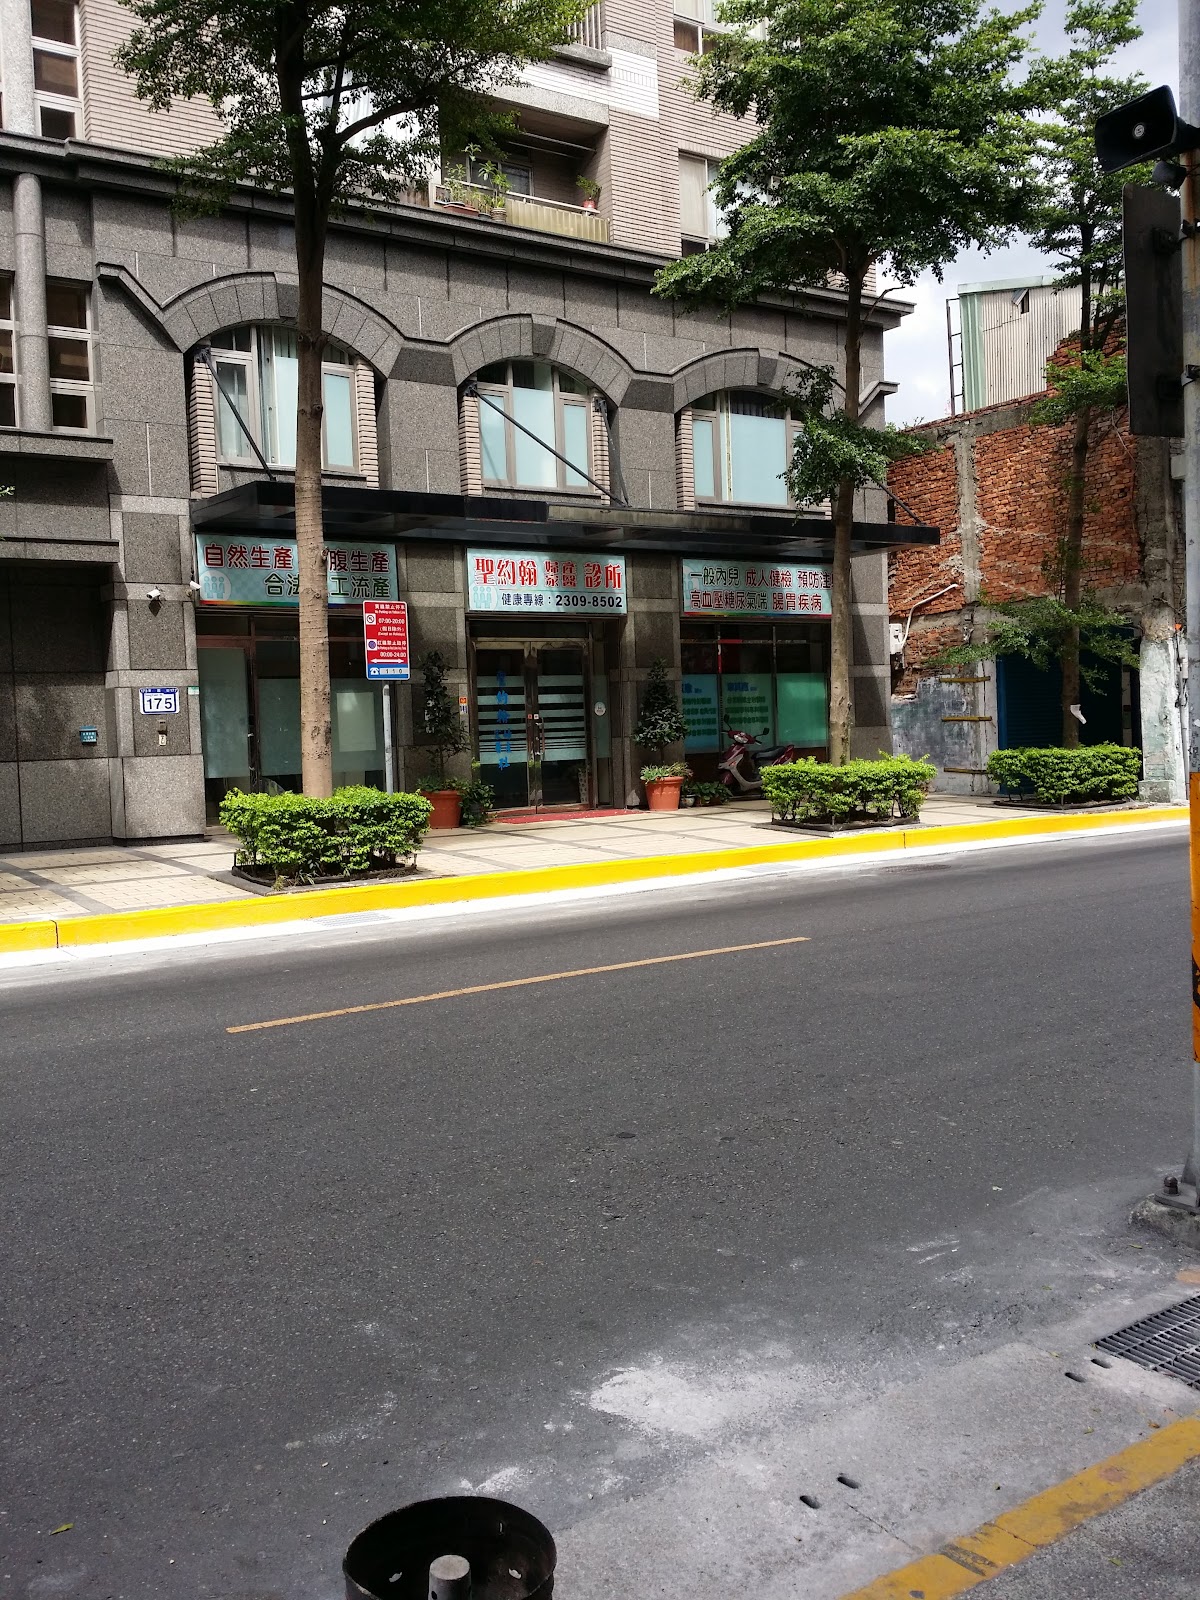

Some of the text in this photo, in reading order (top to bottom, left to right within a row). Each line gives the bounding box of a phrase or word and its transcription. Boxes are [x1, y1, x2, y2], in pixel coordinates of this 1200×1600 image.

[204, 543, 294, 570] 自然生產
[475, 557, 537, 587] 聖約翰
[584, 561, 622, 589] 診所
[745, 568, 793, 588] 成人健檢
[797, 569, 834, 589] 預防注
[146, 697, 173, 710] 175
